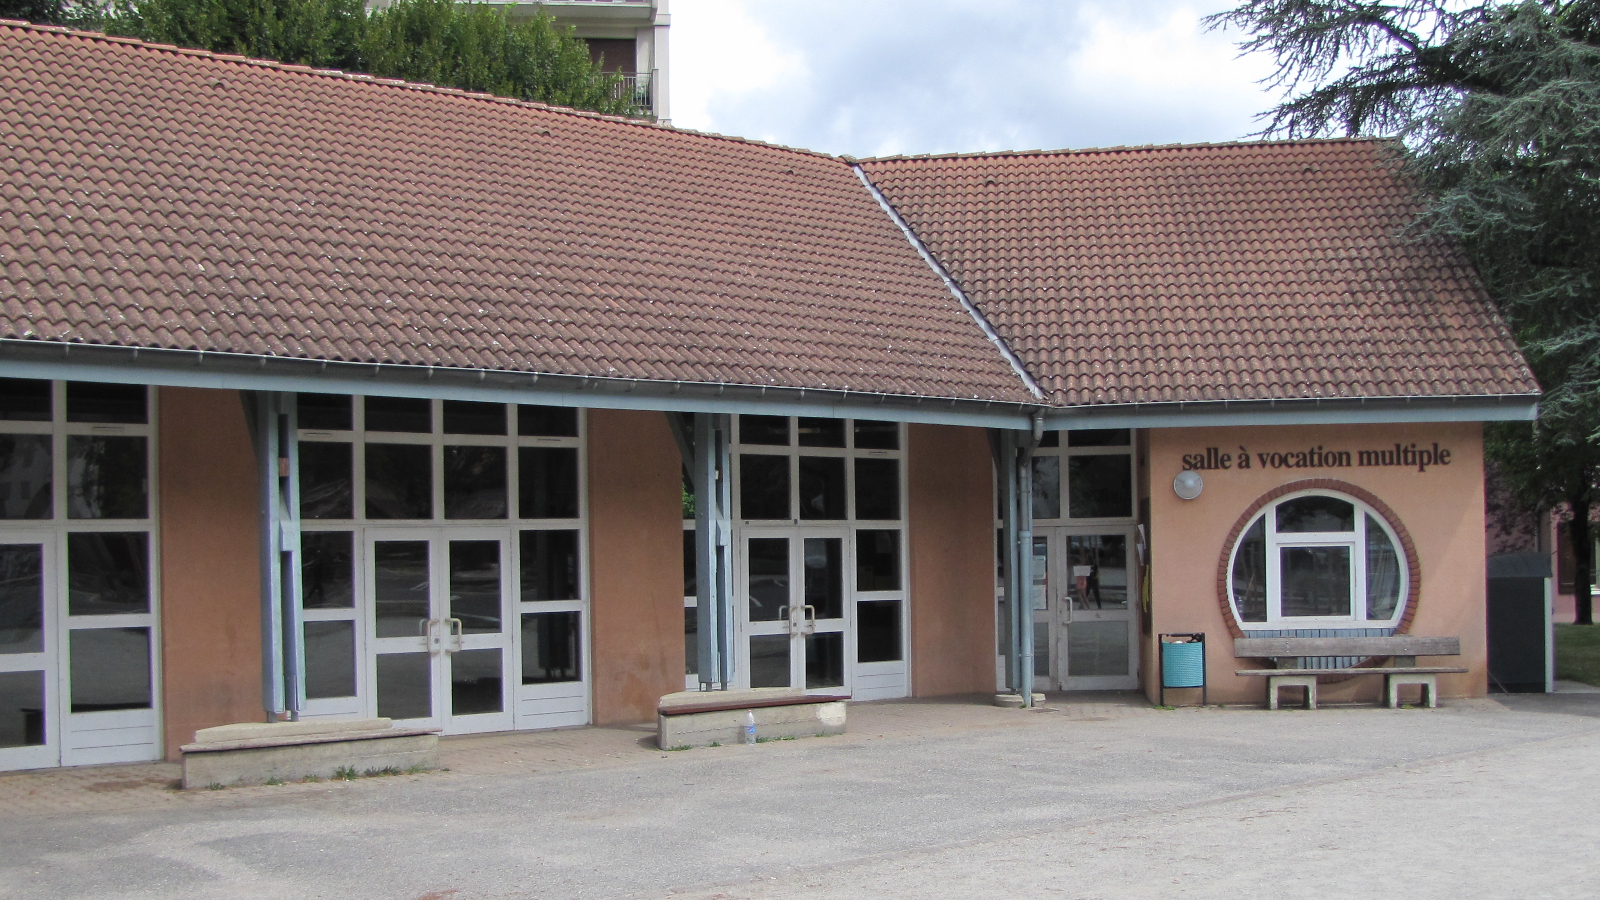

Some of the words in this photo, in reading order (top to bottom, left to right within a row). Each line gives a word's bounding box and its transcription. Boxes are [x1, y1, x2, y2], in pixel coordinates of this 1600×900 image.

[1182, 447, 1232, 470] salle
[1238, 446, 1251, 469] à
[1257, 445, 1352, 469] vocation
[1357, 442, 1451, 472] multiple
